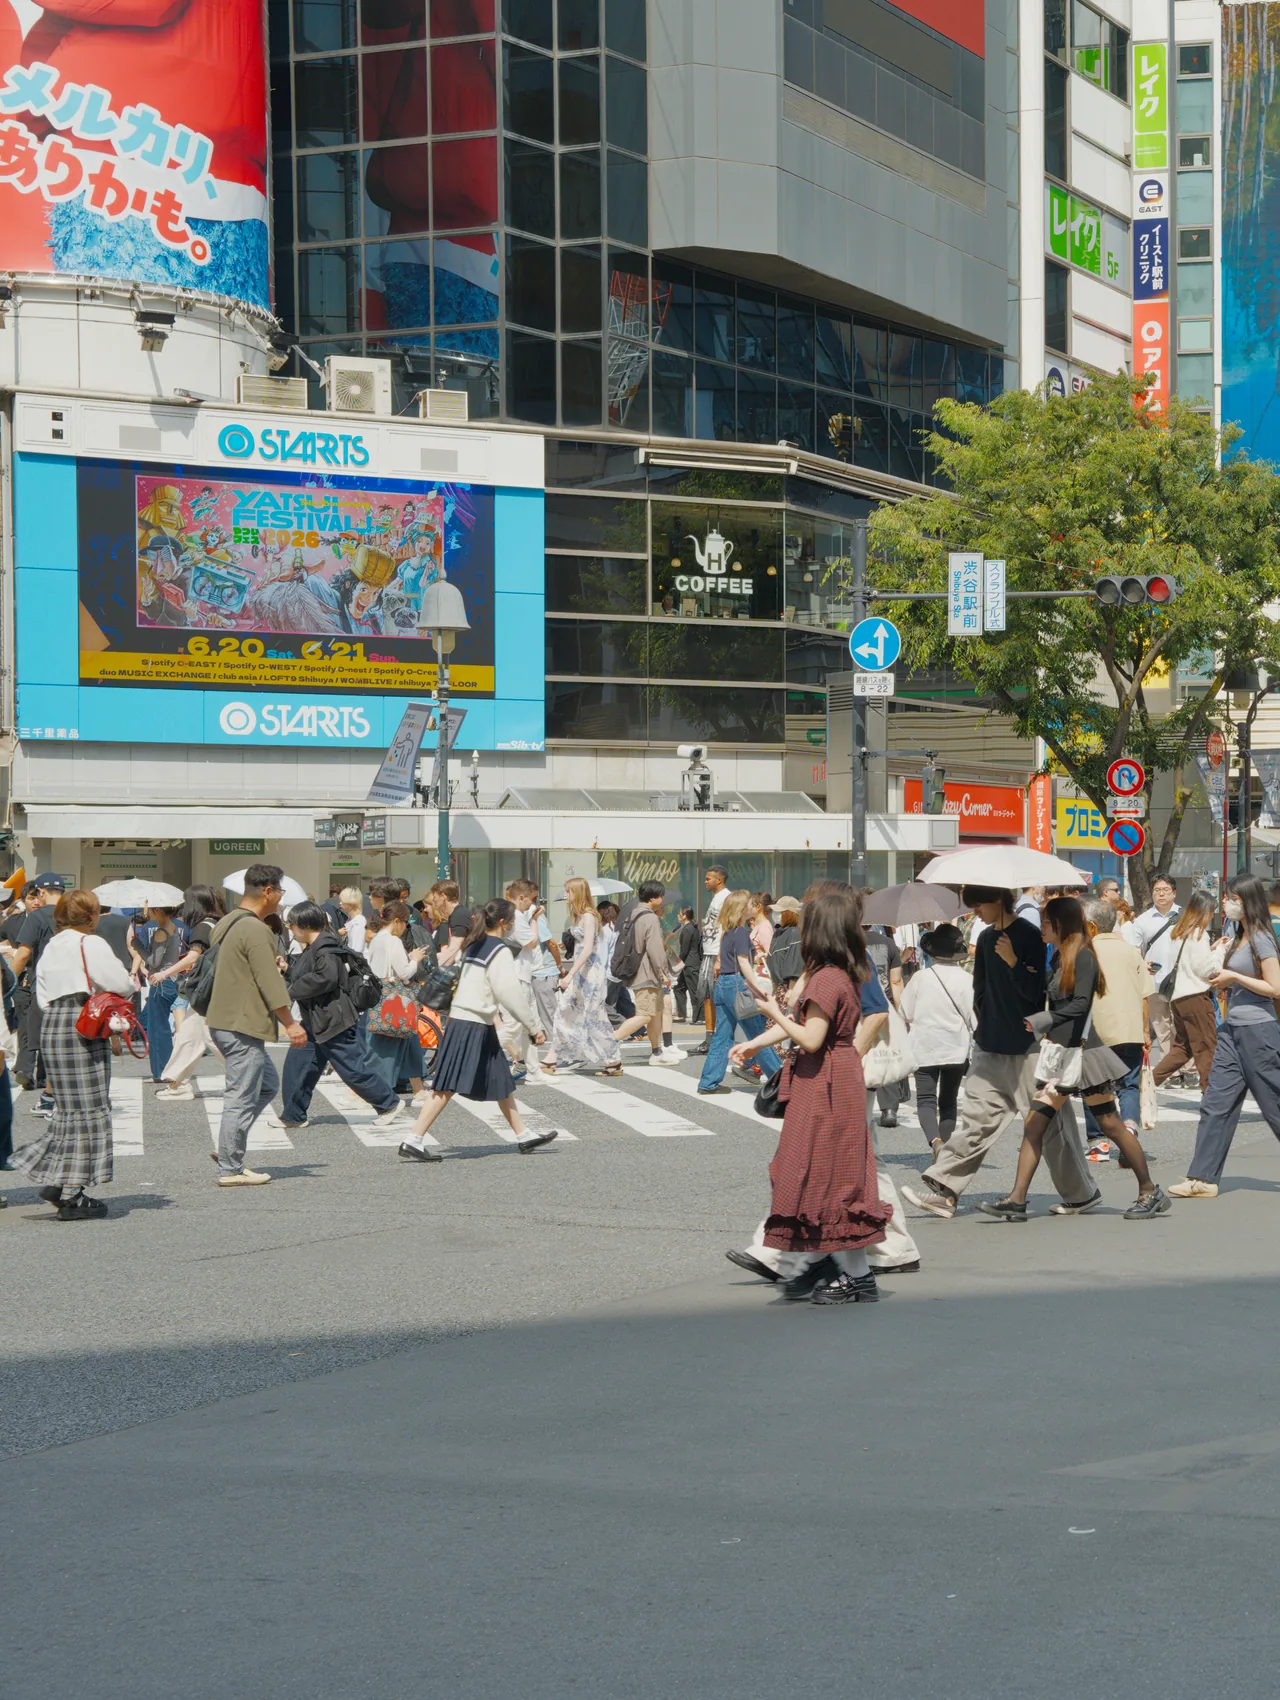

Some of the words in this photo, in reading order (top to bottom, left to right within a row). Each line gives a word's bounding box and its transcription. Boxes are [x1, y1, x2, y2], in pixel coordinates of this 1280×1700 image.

[1139, 55, 1160, 118] レイク
[3, 65, 218, 200] メルカリ、
[0, 121, 209, 263] ありかも。
[1053, 197, 1098, 252] レイク
[1138, 205, 1164, 213] EAST
[1107, 250, 1120, 281] 5F
[1139, 233, 1150, 284] クリニック
[1151, 224, 1164, 290] イースト駅前
[258, 427, 371, 467] STARTS
[232, 489, 339, 514] YATSUI
[264, 528, 320, 549] 2026
[675, 574, 754, 595] COFFEE
[953, 570, 962, 602] Shibuya
[963, 560, 978, 629] 渋谷駅前
[953, 604, 962, 620] Sta.
[187, 635, 265, 659] 6.20
[266, 649, 296, 660] Sat.
[301, 640, 368, 662] 6.21
[368, 653, 399, 663] Sun.
[99, 668, 117, 676] duo
[118, 669, 154, 678] MUSIC
[155, 671, 212, 680] EXCHANGE
[218, 672, 237, 681] club
[238, 673, 258, 682] asia
[263, 674, 297, 683] LOFT9
[298, 675, 334, 685] Shibuya
[339, 676, 393, 686] WOMBLIVE
[398, 679, 431, 688] shibuya
[141, 658, 176, 668] Spotify
[177, 659, 216, 668] O-EAST
[223, 661, 257, 671] Spotify
[258, 662, 292, 671] O-WEST
[303, 664, 337, 674] Spotify
[373, 667, 405, 677] Spotify
[407, 668, 439, 677] O-Cres
[259, 702, 371, 738] STARTS
[961, 792, 994, 817] Corner
[214, 841, 262, 853] UGREEN
